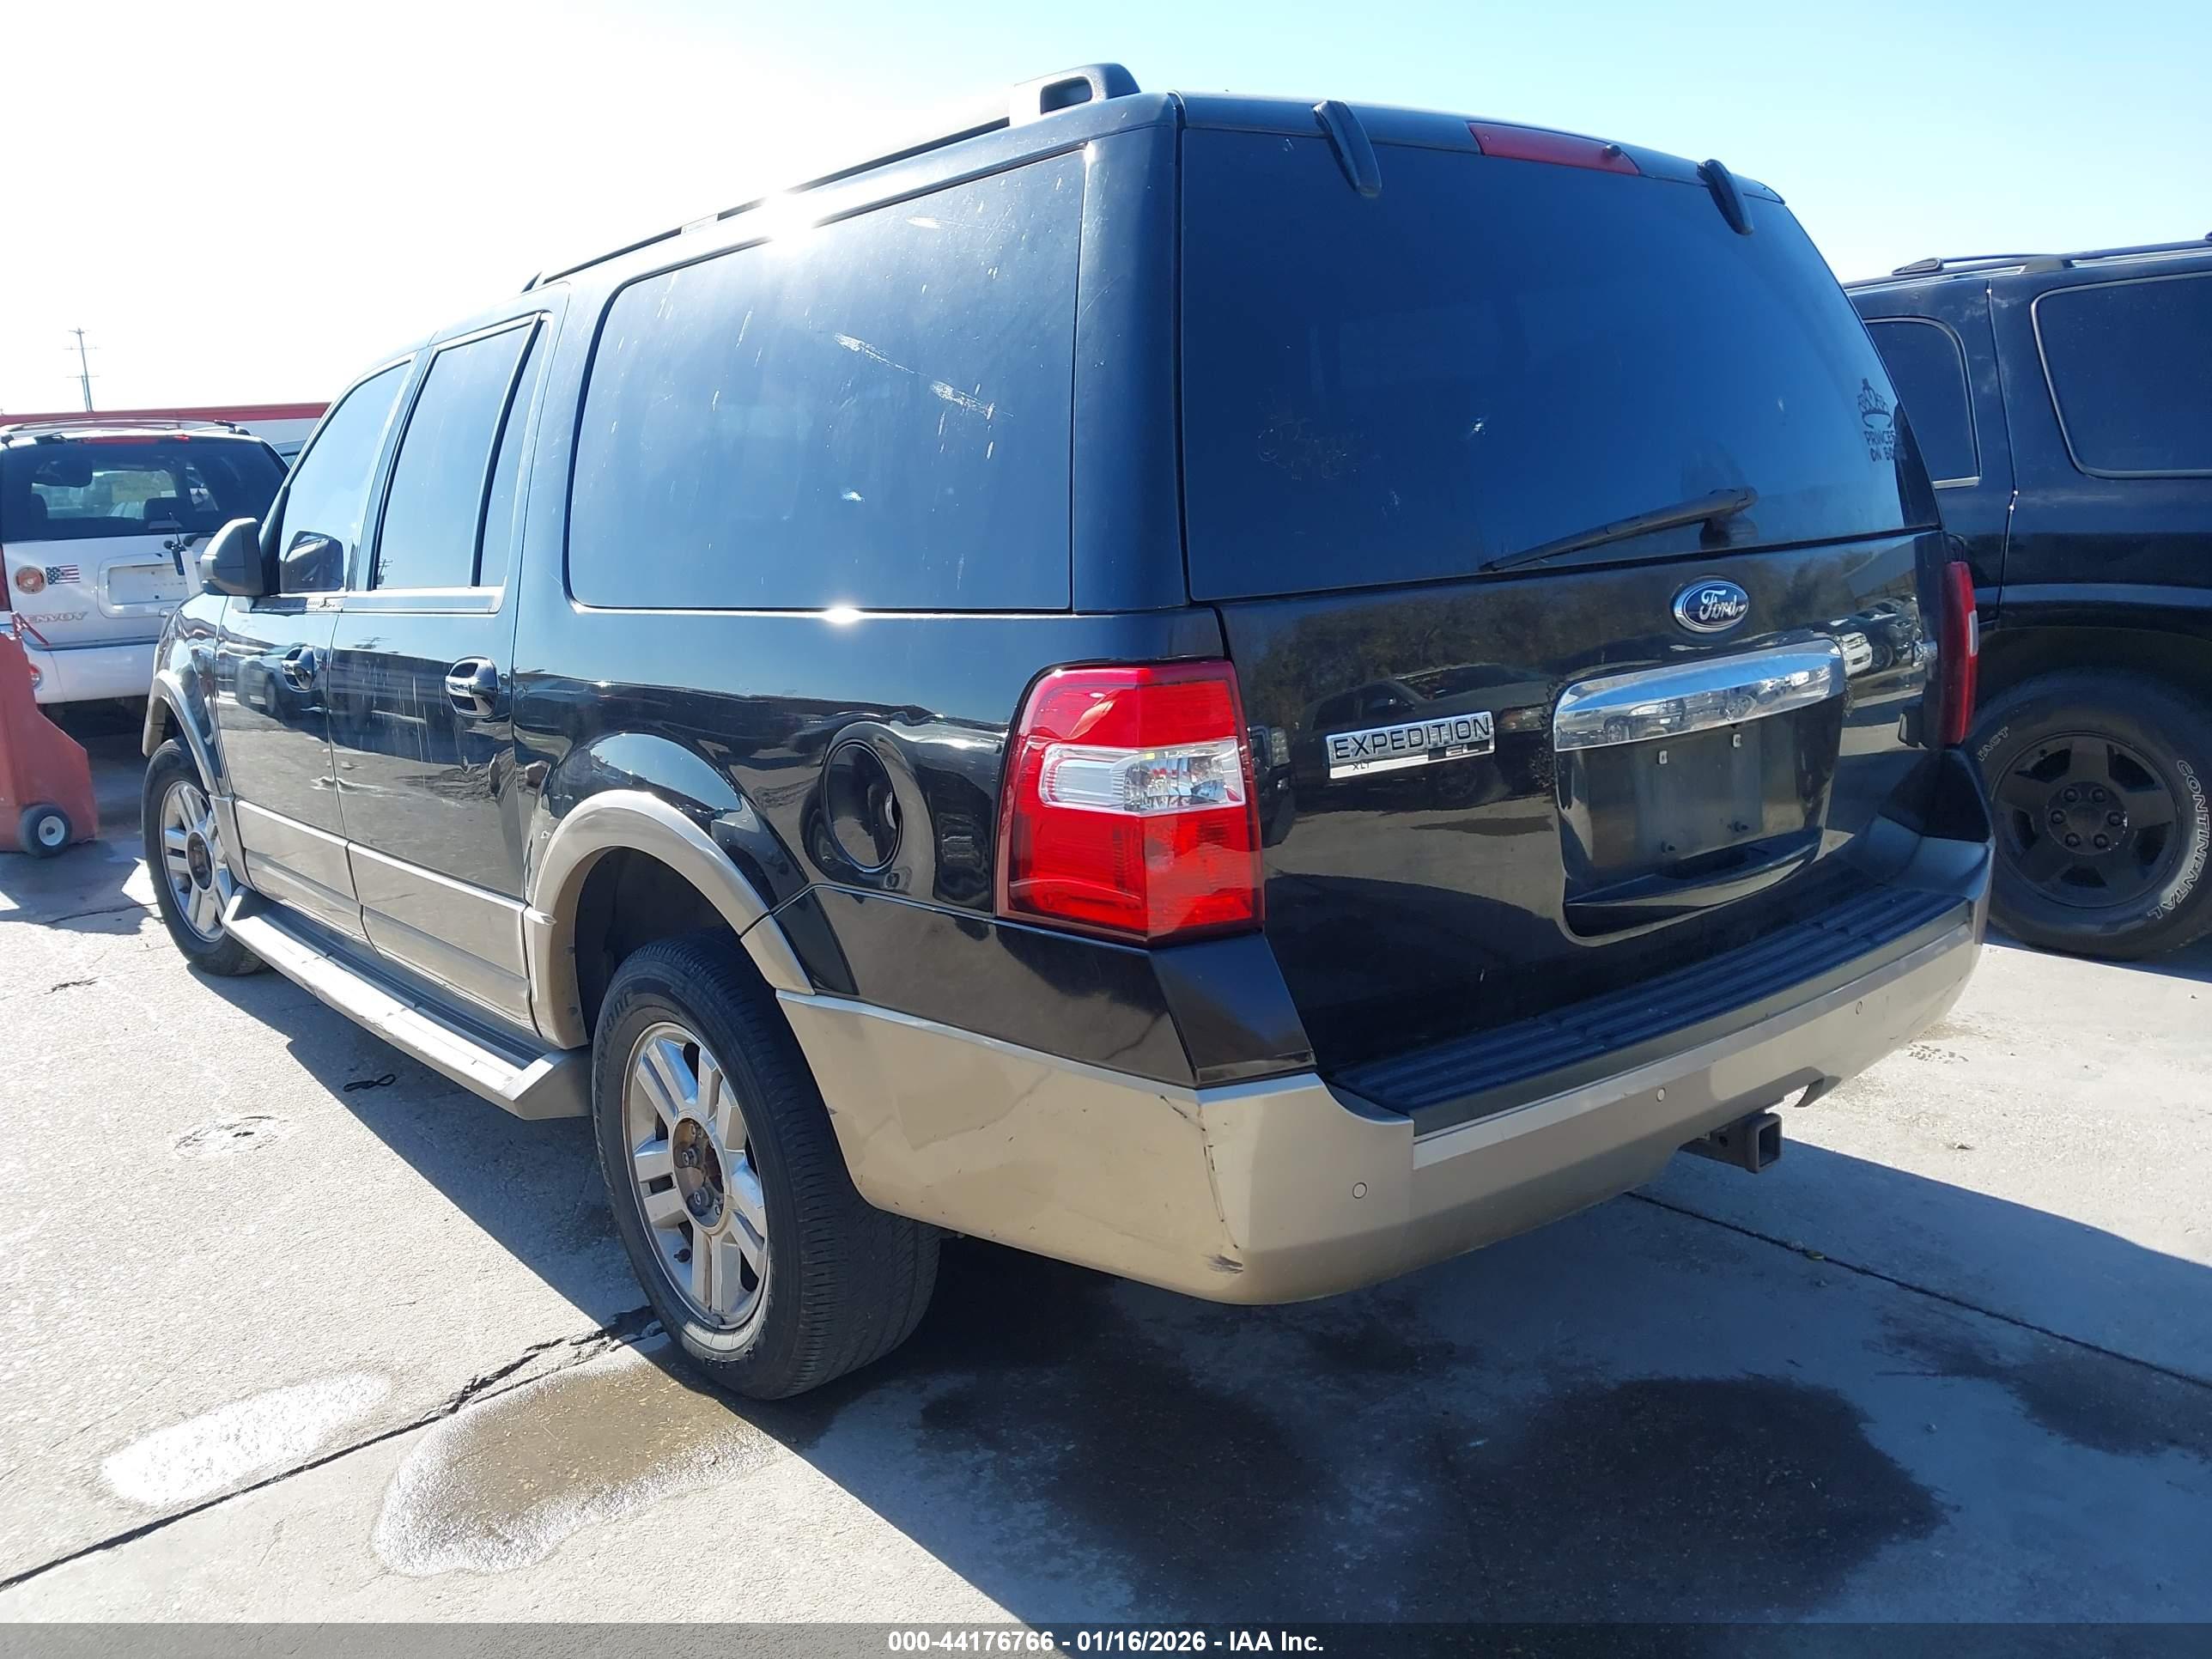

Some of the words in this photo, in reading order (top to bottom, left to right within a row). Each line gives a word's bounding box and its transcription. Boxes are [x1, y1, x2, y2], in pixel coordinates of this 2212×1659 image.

[1698, 589, 1746, 620] Ford
[24, 611, 88, 624] ENVOY
[1332, 715, 1491, 760] EXPEDITION
[1444, 744, 1480, 757] EL
[1352, 761, 1371, 771] XLT
[2147, 758, 2210, 921] CONTINENTAL
